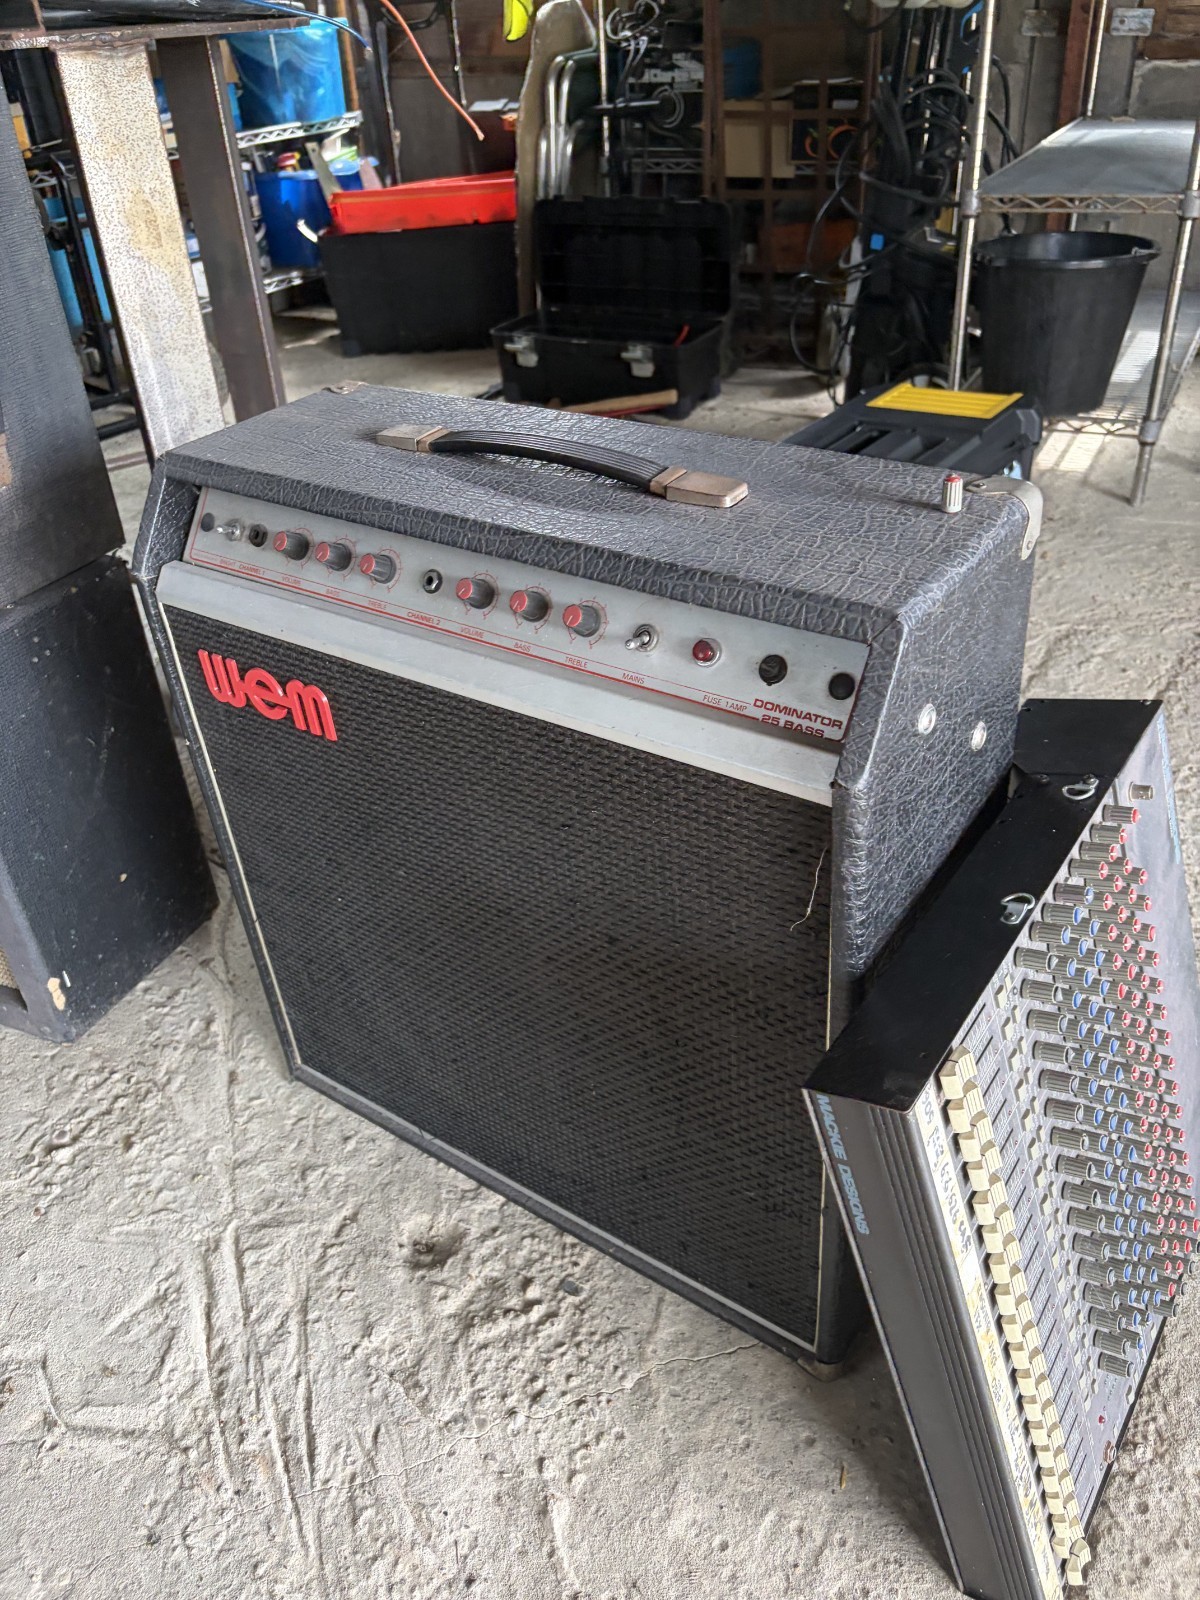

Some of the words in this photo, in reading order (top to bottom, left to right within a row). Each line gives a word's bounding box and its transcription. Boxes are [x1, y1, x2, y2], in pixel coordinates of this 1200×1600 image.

[367, 599, 387, 611] TREBLE
[406, 611, 434, 624] CHANNEL
[460, 626, 484, 639] VOLUME
[513, 641, 531, 653] BASS
[564, 655, 588, 669] TREBLE
[622, 672, 645, 685] MAINS
[702, 694, 722, 707] FUSE
[753, 698, 844, 730] DOMINATOR
[760, 713, 780, 727] 25
[782, 720, 826, 739] BASS
[816, 1094, 848, 1161] MACKIE
[838, 1163, 870, 1236] DESIGNS
